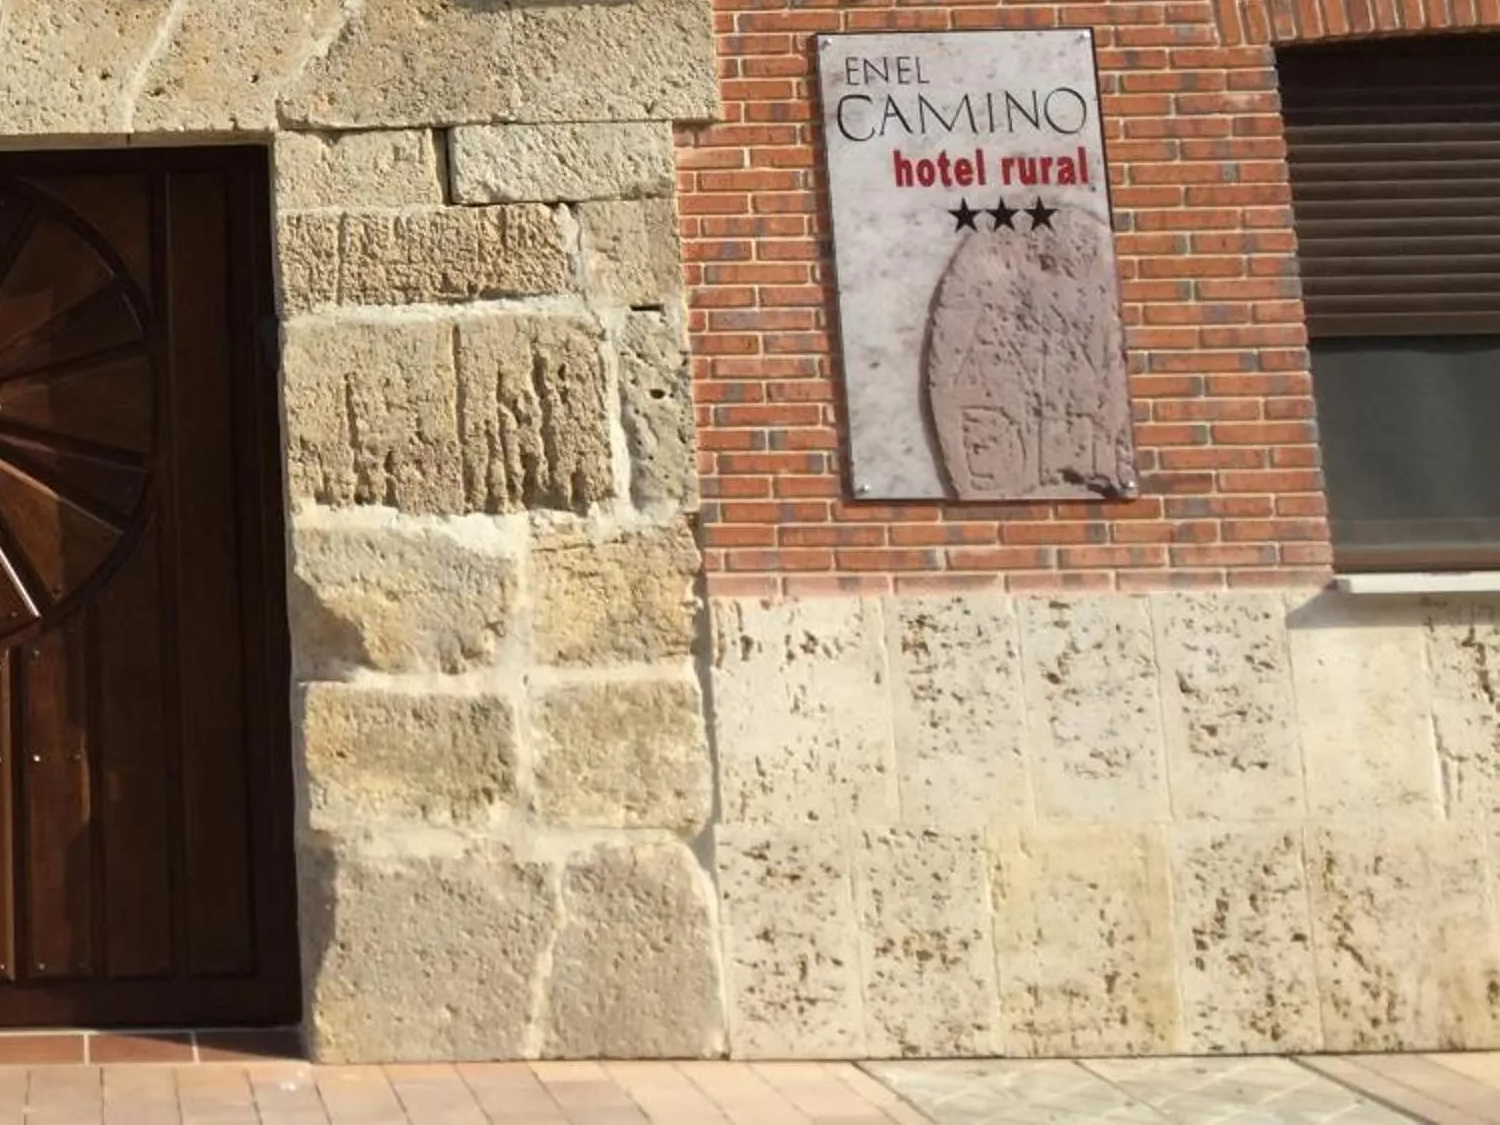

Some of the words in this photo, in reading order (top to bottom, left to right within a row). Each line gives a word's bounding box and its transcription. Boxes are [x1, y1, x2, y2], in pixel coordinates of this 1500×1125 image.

[836, 86, 1088, 143] CAMINO
[892, 147, 987, 188] hotel
[1000, 146, 1090, 186] rural
